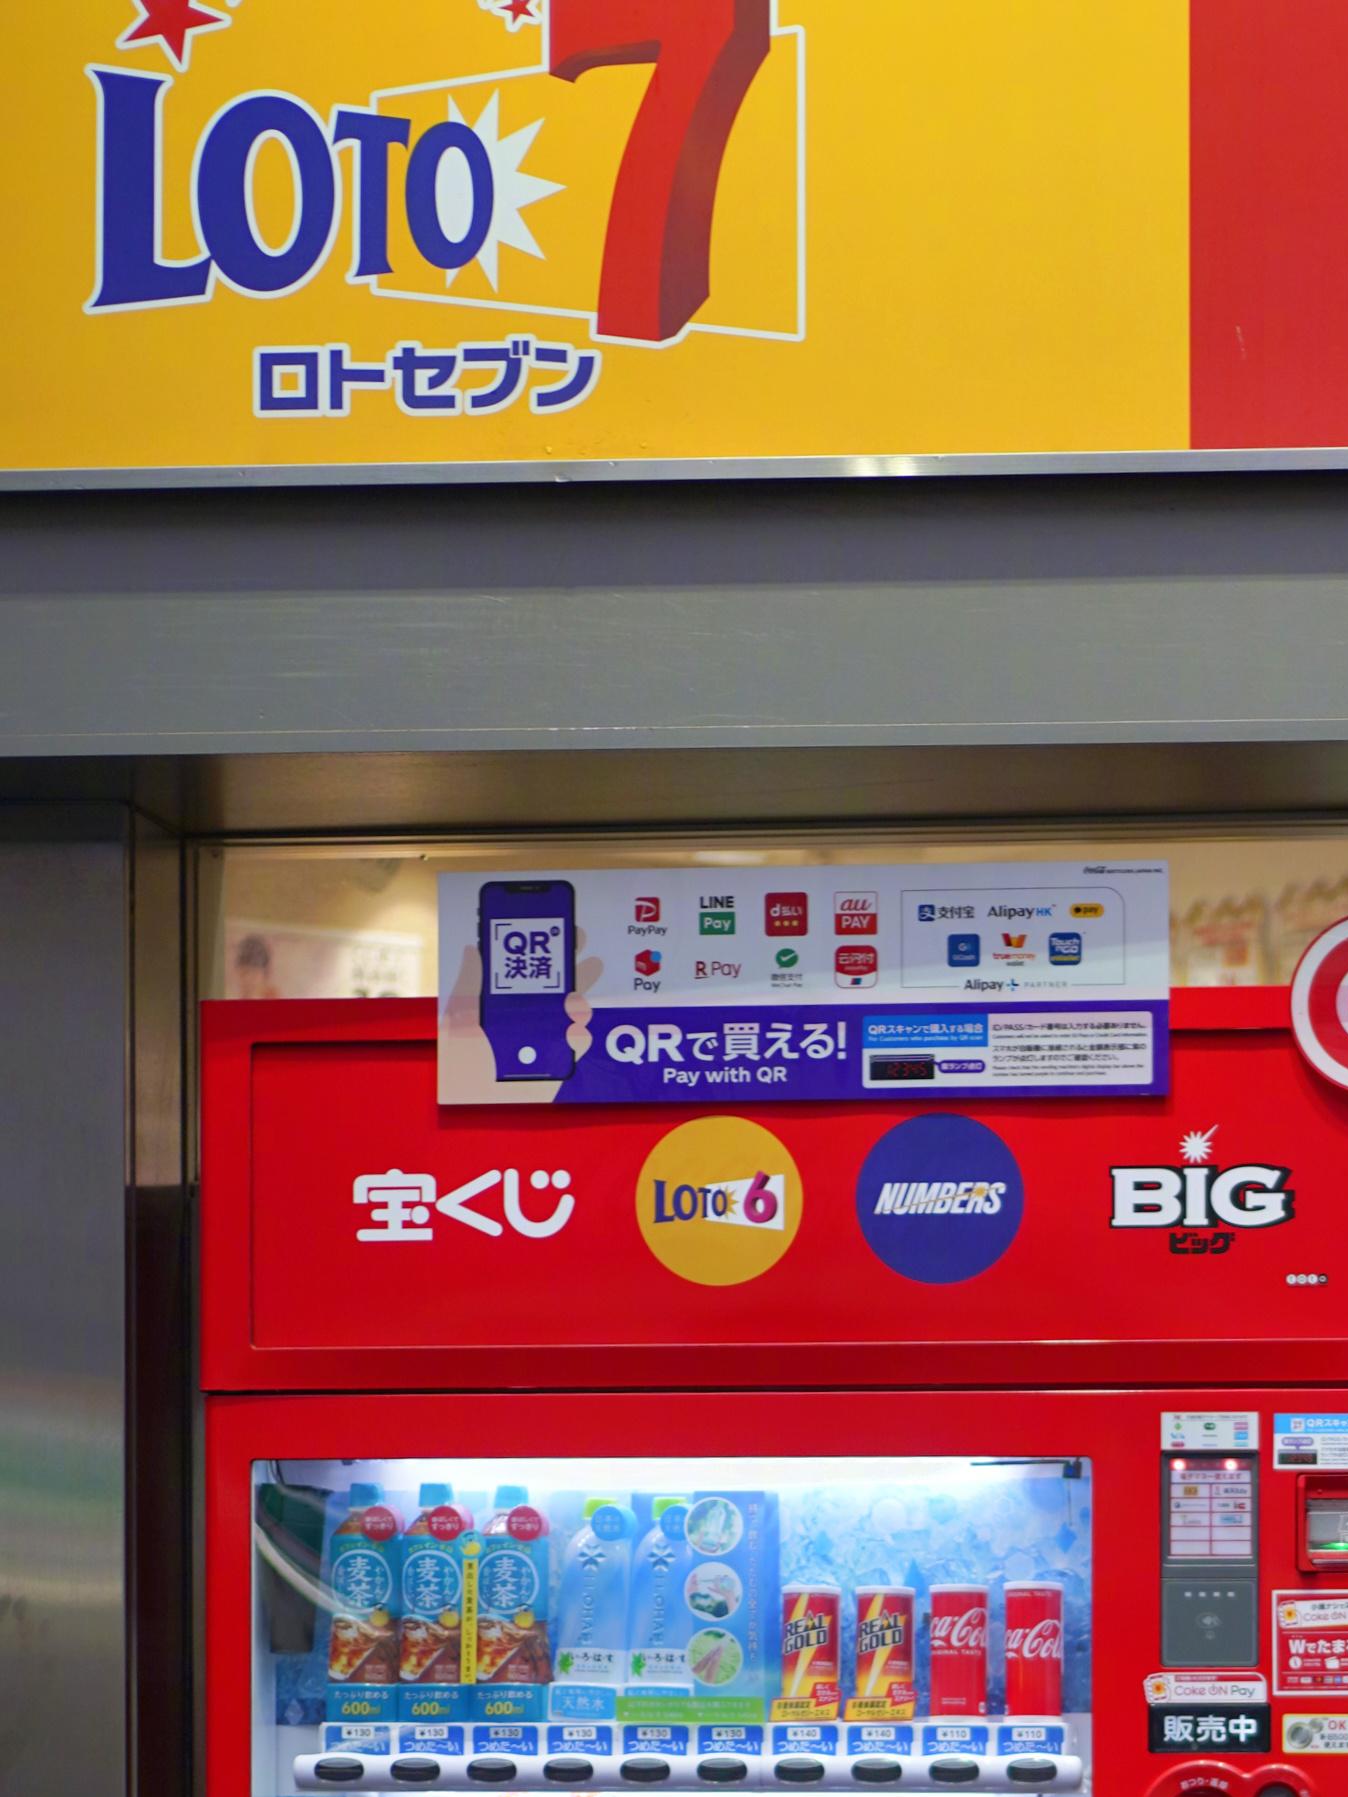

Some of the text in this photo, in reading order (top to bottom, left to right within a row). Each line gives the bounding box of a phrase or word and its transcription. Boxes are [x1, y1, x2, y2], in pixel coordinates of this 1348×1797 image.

[88, 67, 496, 309] LOTO
[256, 340, 597, 412] ロトセブン
[699, 896, 734, 909] LINE
[840, 898, 873, 912] au
[627, 925, 668, 936] PayPay
[703, 917, 732, 931] Pay
[841, 915, 871, 928] PAY
[503, 931, 552, 956] QR
[504, 956, 553, 980] 決済
[710, 960, 742, 978] Pay
[633, 979, 662, 994] Pay
[963, 978, 1004, 992] Alipay
[663, 1066, 787, 1086] Pay with QR
[352, 1168, 576, 1242] 宝くじ
[653, 1170, 778, 1224] LOTO 6
[873, 1181, 1007, 1216] NUMBERS
[1109, 1165, 1295, 1229] BIG
[1168, 1232, 1236, 1255] ビッグ
[346, 1555, 374, 1608] 麦茶
[415, 1556, 442, 1608] 麦茶
[491, 1556, 519, 1608] 麦茶
[784, 1610, 827, 1635] REAL
[859, 1609, 904, 1634] REAL
[783, 1630, 828, 1656] GOLD
[858, 1629, 903, 1656] GOLD
[1174, 1685, 1206, 1696] Coke
[1231, 1684, 1256, 1698] Pay
[1163, 1714, 1258, 1743] 販売中
[1327, 1719, 1348, 1731] OK
